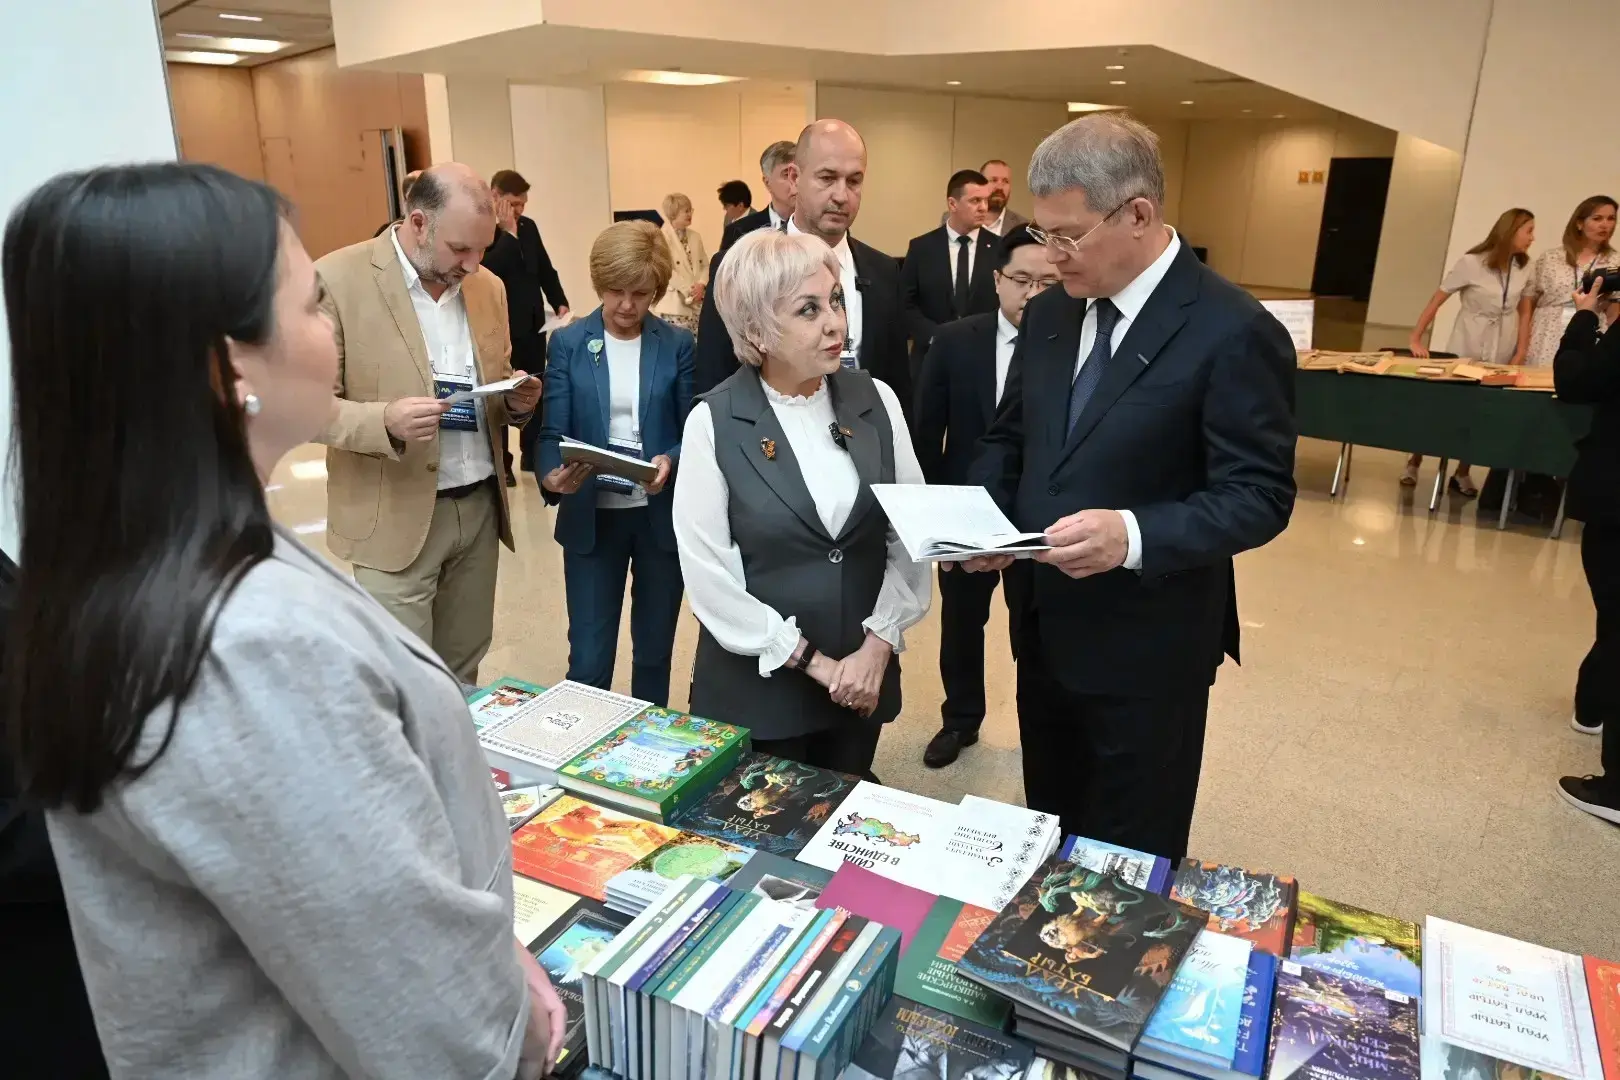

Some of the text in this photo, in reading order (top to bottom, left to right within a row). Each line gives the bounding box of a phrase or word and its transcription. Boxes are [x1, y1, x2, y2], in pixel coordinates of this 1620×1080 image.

[722, 821, 760, 840] УРАЛ
[827, 838, 901, 866] В ЕДИНСТВЕ
[842, 853, 875, 869] СИЛА
[1025, 962, 1080, 1000] УРАЛ
[1029, 952, 1092, 987] БАТЫР
[916, 972, 987, 1000] БАШКИРСКИЕ
[1468, 993, 1548, 1022] УРАЛ БАТЫР
[1470, 1013, 1550, 1042] УРАЛ БАТЫР
